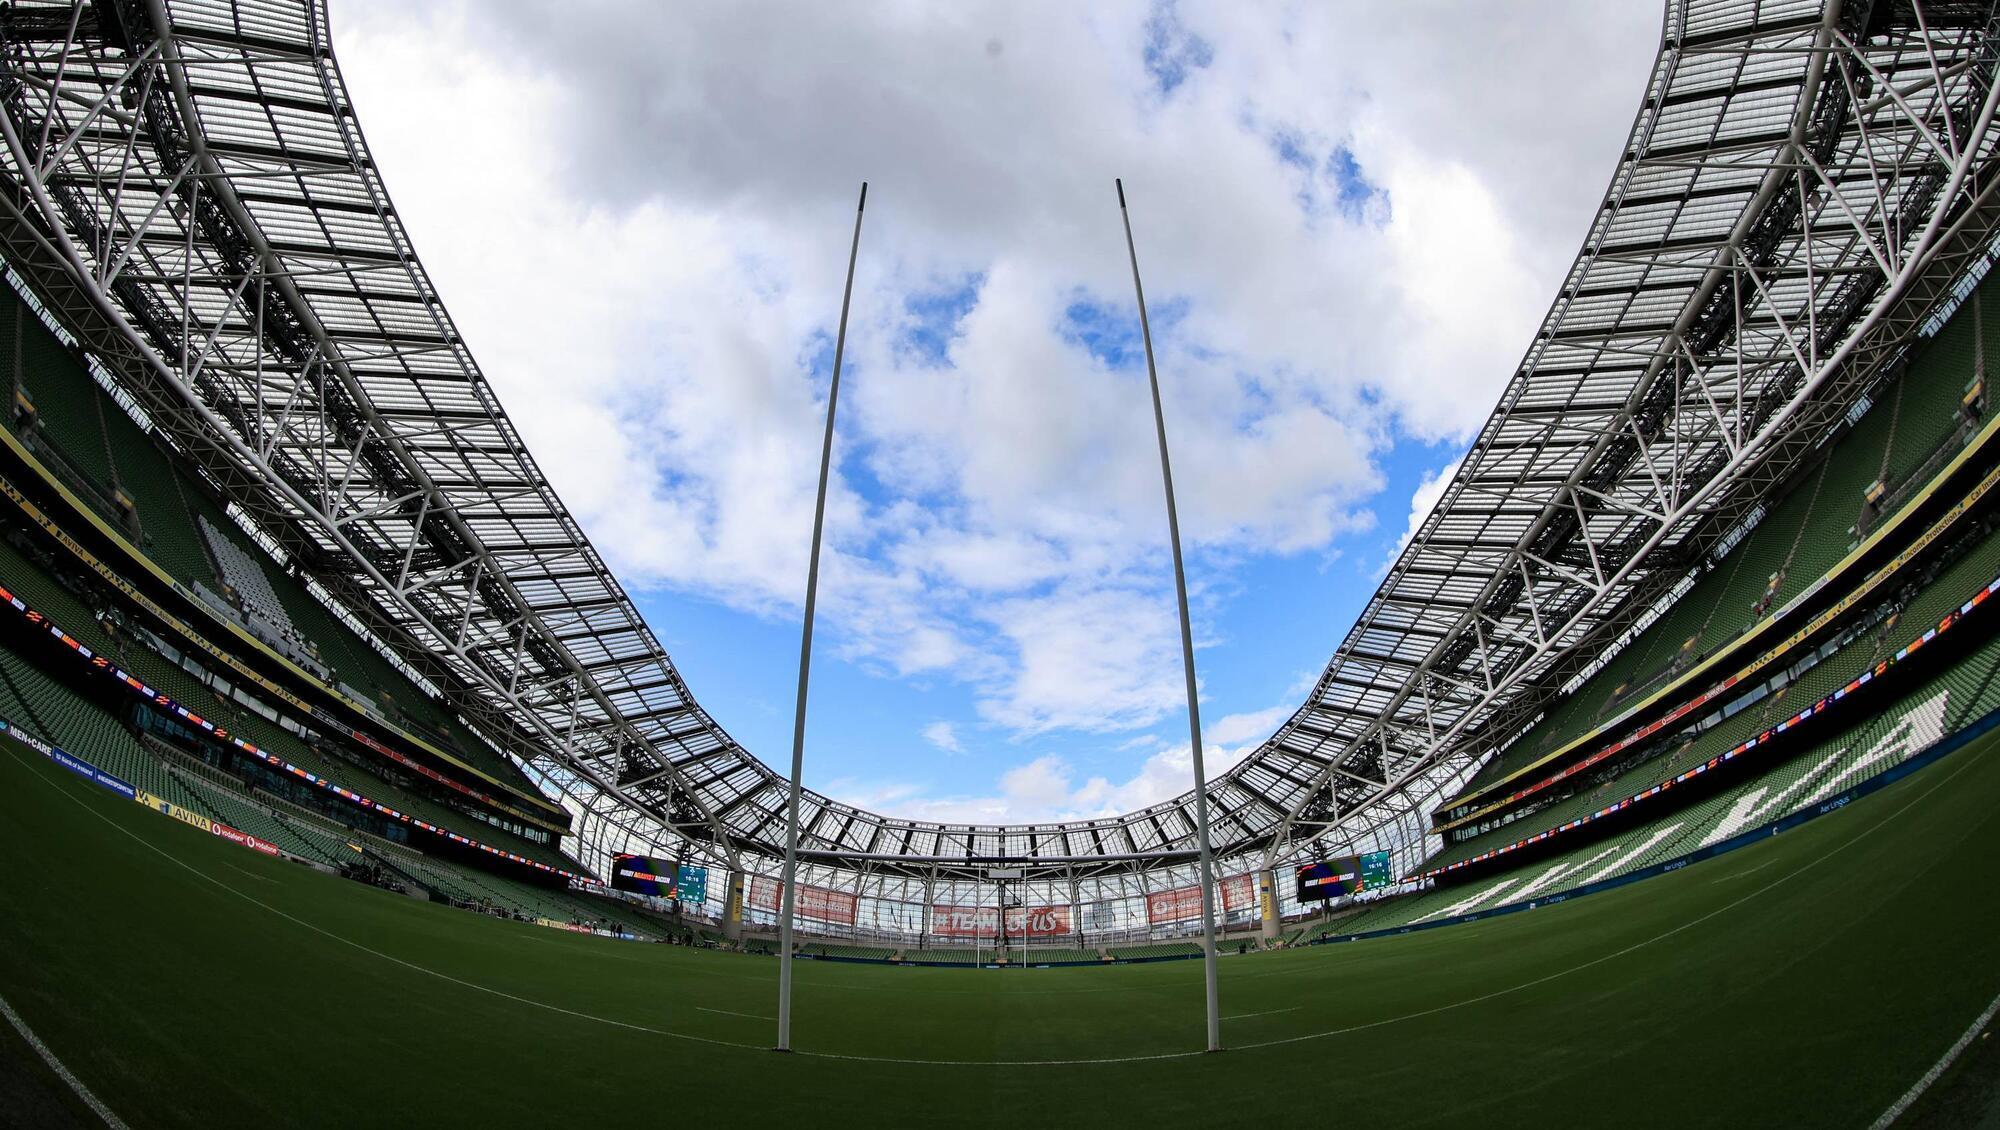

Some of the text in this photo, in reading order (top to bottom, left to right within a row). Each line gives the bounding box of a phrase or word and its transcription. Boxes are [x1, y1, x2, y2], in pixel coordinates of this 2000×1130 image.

[1903, 512, 1958, 560] Income Protection
[62, 537, 84, 556] AVIVA
[1848, 565, 1894, 603] Home Insurance
[190, 596, 228, 626] AVIVA STADIUM
[1809, 615, 1828, 632] AVIVA
[10, 725, 53, 757] MEN+CARE
[1820, 796, 1850, 814] Aer Lingus
[174, 808, 208, 830] AVIVA
[221, 830, 244, 843] vodafone
[255, 842, 277, 855] vodafone
